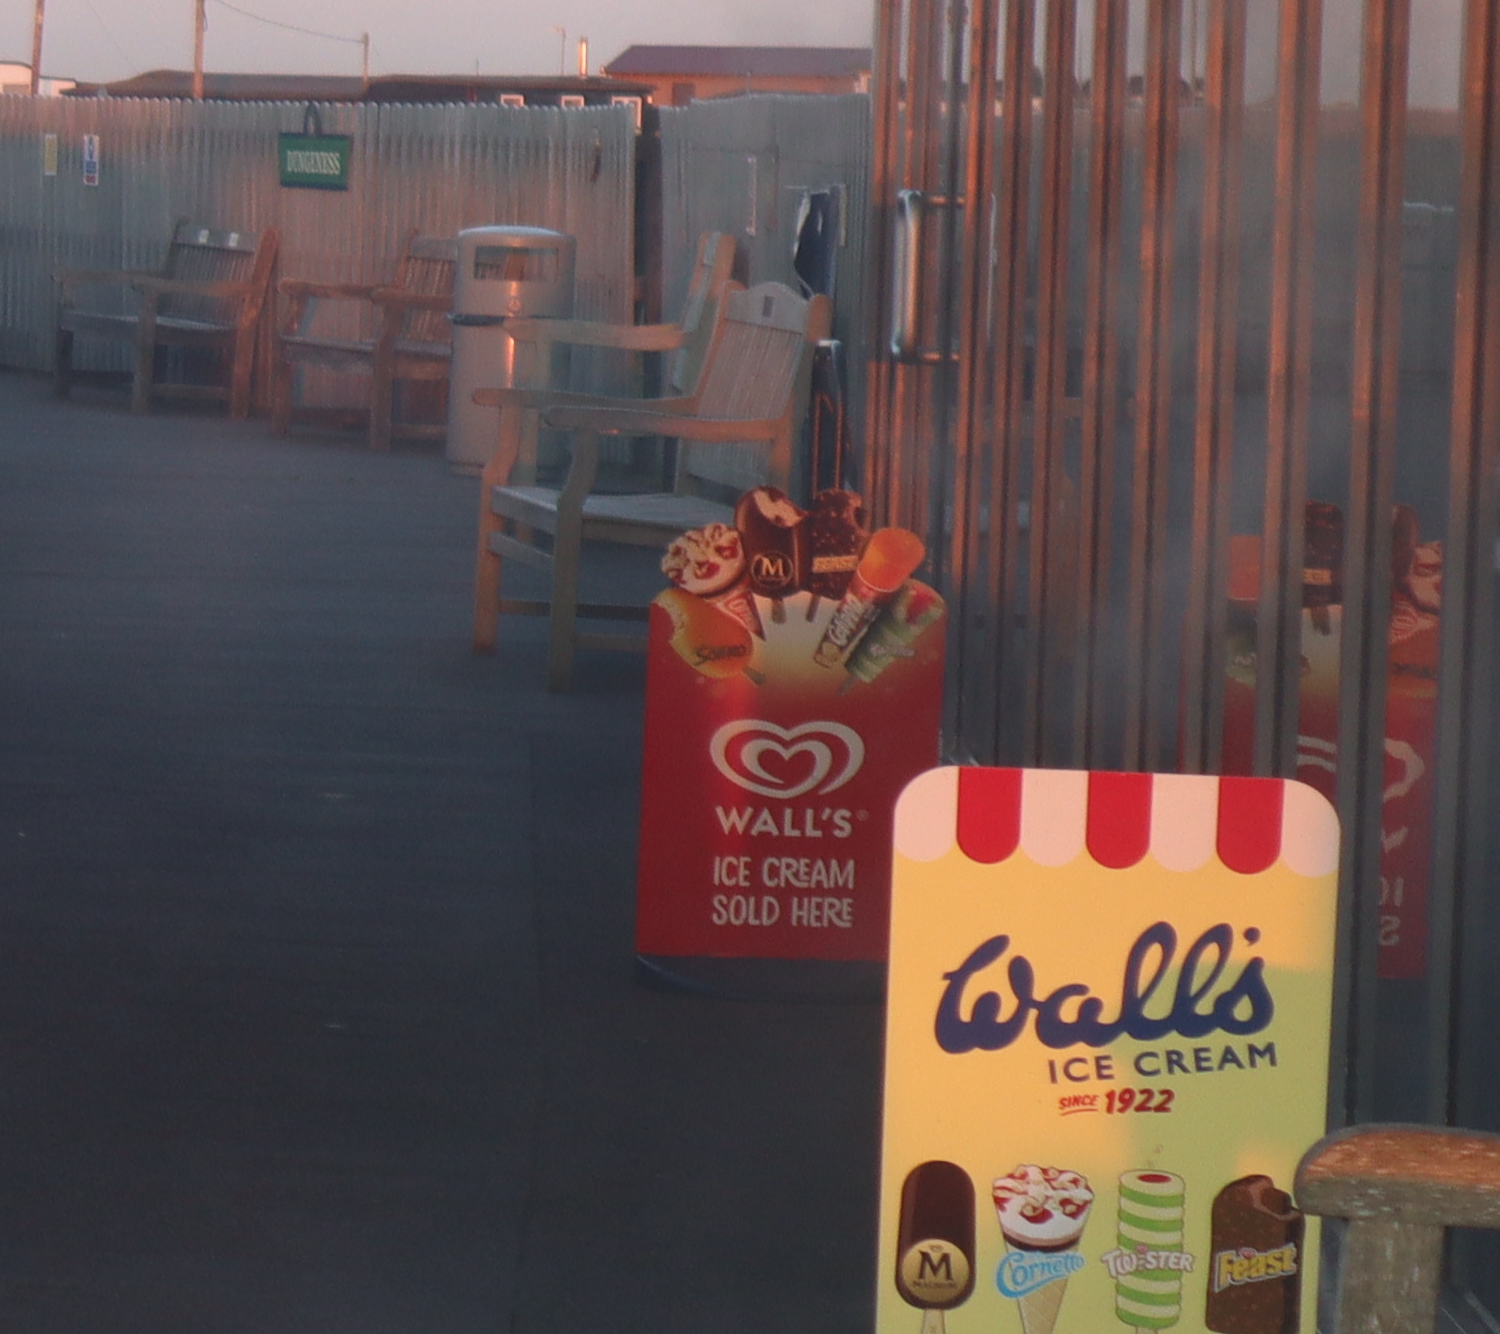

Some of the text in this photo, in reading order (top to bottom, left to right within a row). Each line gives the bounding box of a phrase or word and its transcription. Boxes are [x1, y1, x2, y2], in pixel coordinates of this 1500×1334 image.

[286, 150, 341, 175] DUNGENESS
[714, 805, 853, 839] WALL'S
[712, 855, 856, 890] ICE CREAM
[711, 894, 854, 929] SOLD HERE
[934, 921, 1275, 1055] Wall's
[1048, 1041, 1278, 1085] ICE CREAM
[1058, 1087, 1176, 1115] SINCE 1922
[918, 1249, 954, 1282] M
[996, 1251, 1086, 1299] Cornetto
[1214, 1242, 1298, 1294] Feast
